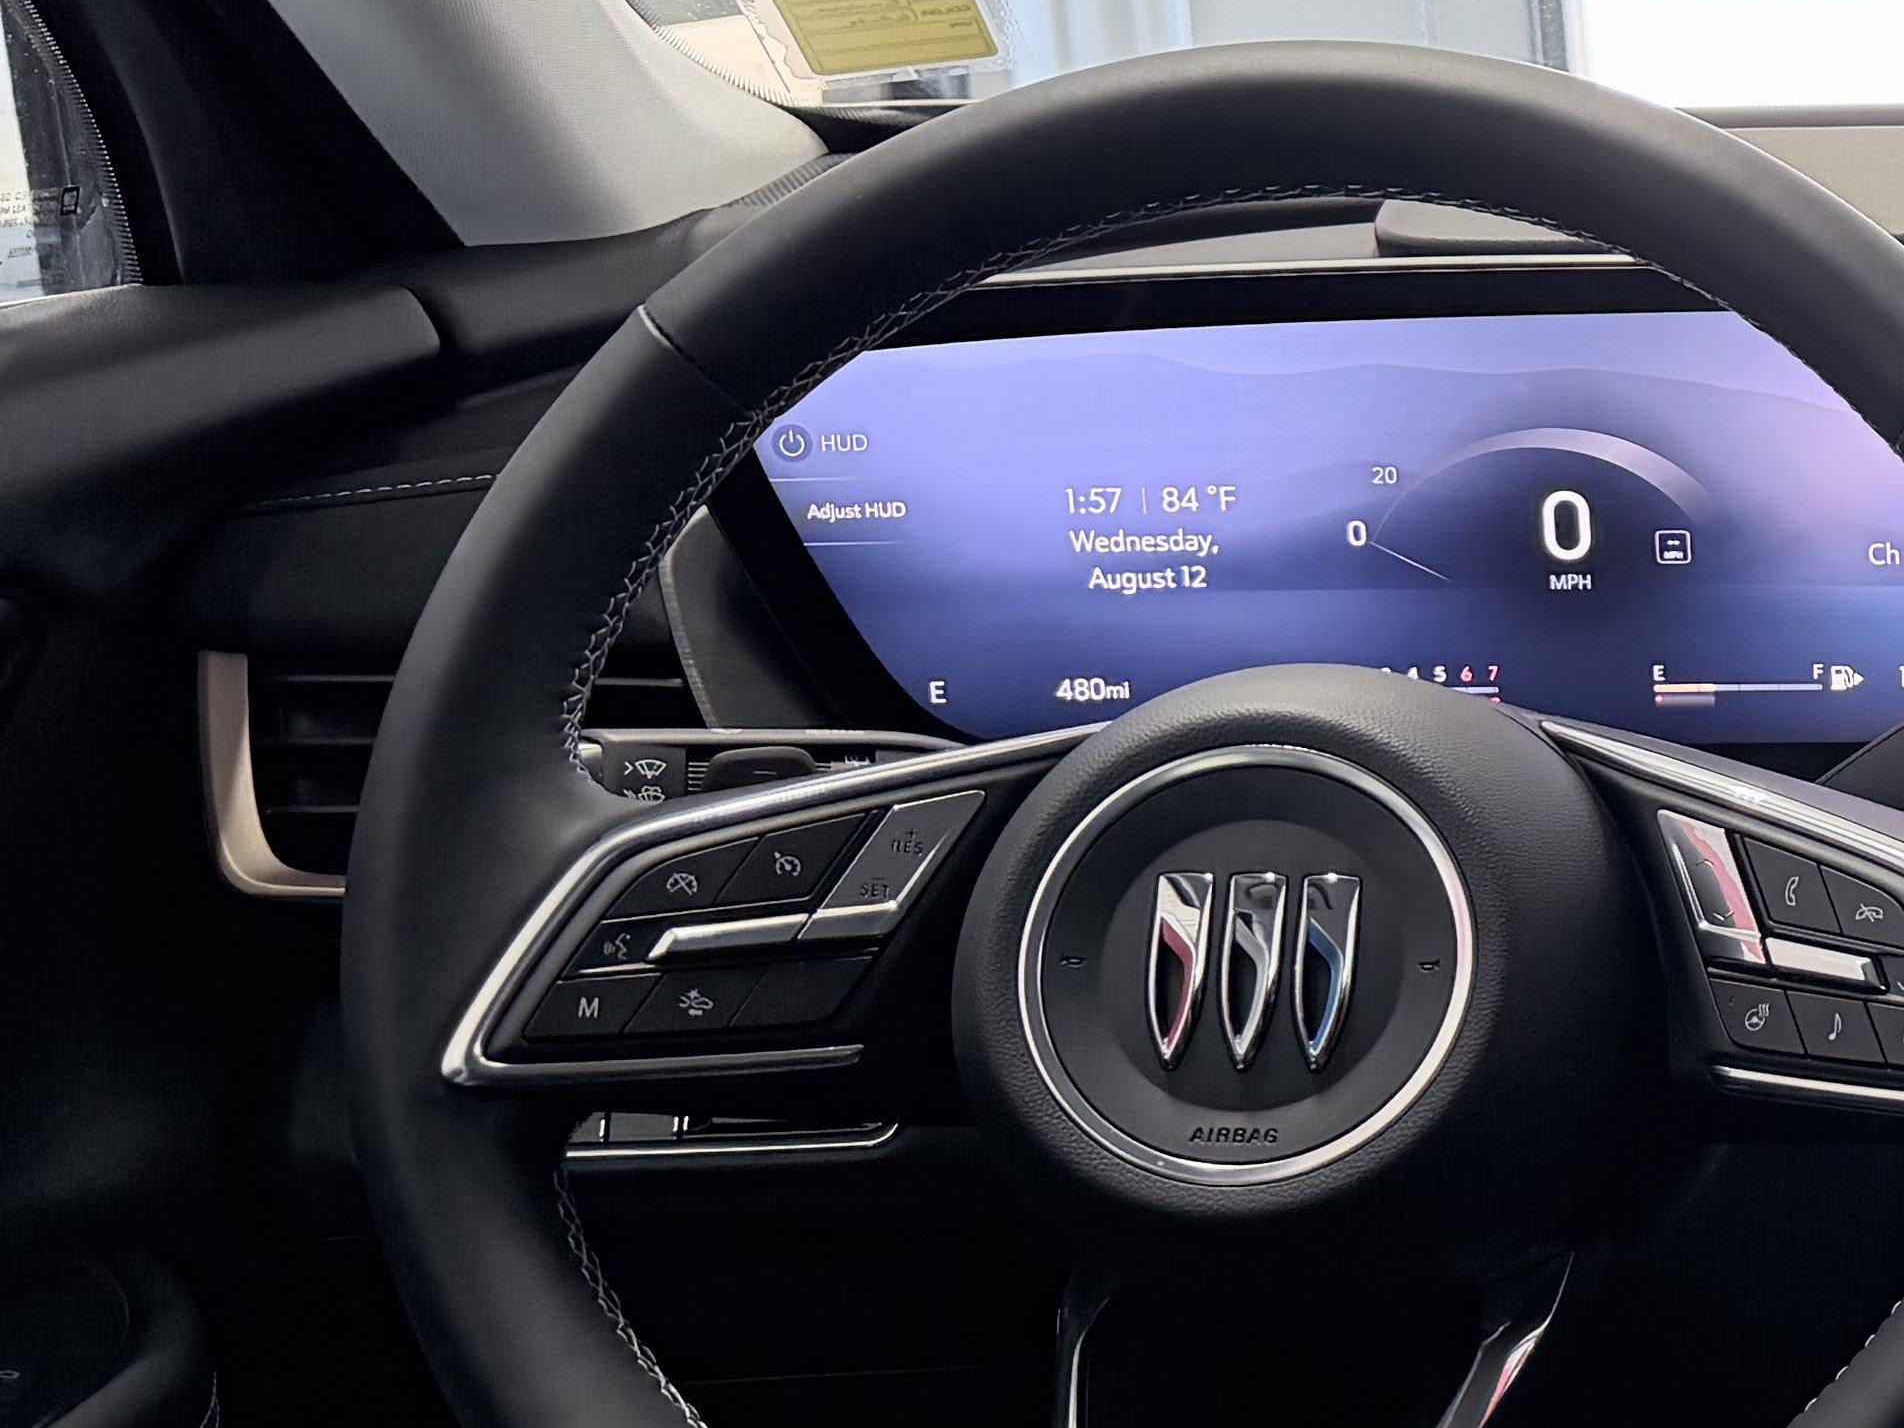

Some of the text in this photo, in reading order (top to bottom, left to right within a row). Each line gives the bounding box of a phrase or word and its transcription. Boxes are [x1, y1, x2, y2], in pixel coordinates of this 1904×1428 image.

[820, 434, 869, 453] HUD
[1371, 466, 1398, 485] 20
[806, 501, 908, 523] Adjust HUD
[1064, 487, 1123, 515] 1:57
[1161, 487, 1199, 513] 84
[1346, 520, 1368, 547] 0
[1541, 490, 1593, 562] 0
[1069, 528, 1220, 556] Wednesday,
[1868, 542, 1900, 566] Ch
[1088, 565, 1208, 595] August 12
[1548, 574, 1593, 591] MPH
[1433, 665, 1447, 683] 5
[1460, 665, 1473, 682] 6
[1487, 665, 1499, 682] 7
[1652, 663, 1824, 682] E F
[929, 680, 948, 705] E
[1055, 678, 1131, 703] 480mi
[859, 881, 890, 899] SET
[578, 996, 600, 1019] M
[1188, 1126, 1279, 1144] AIRBAG
